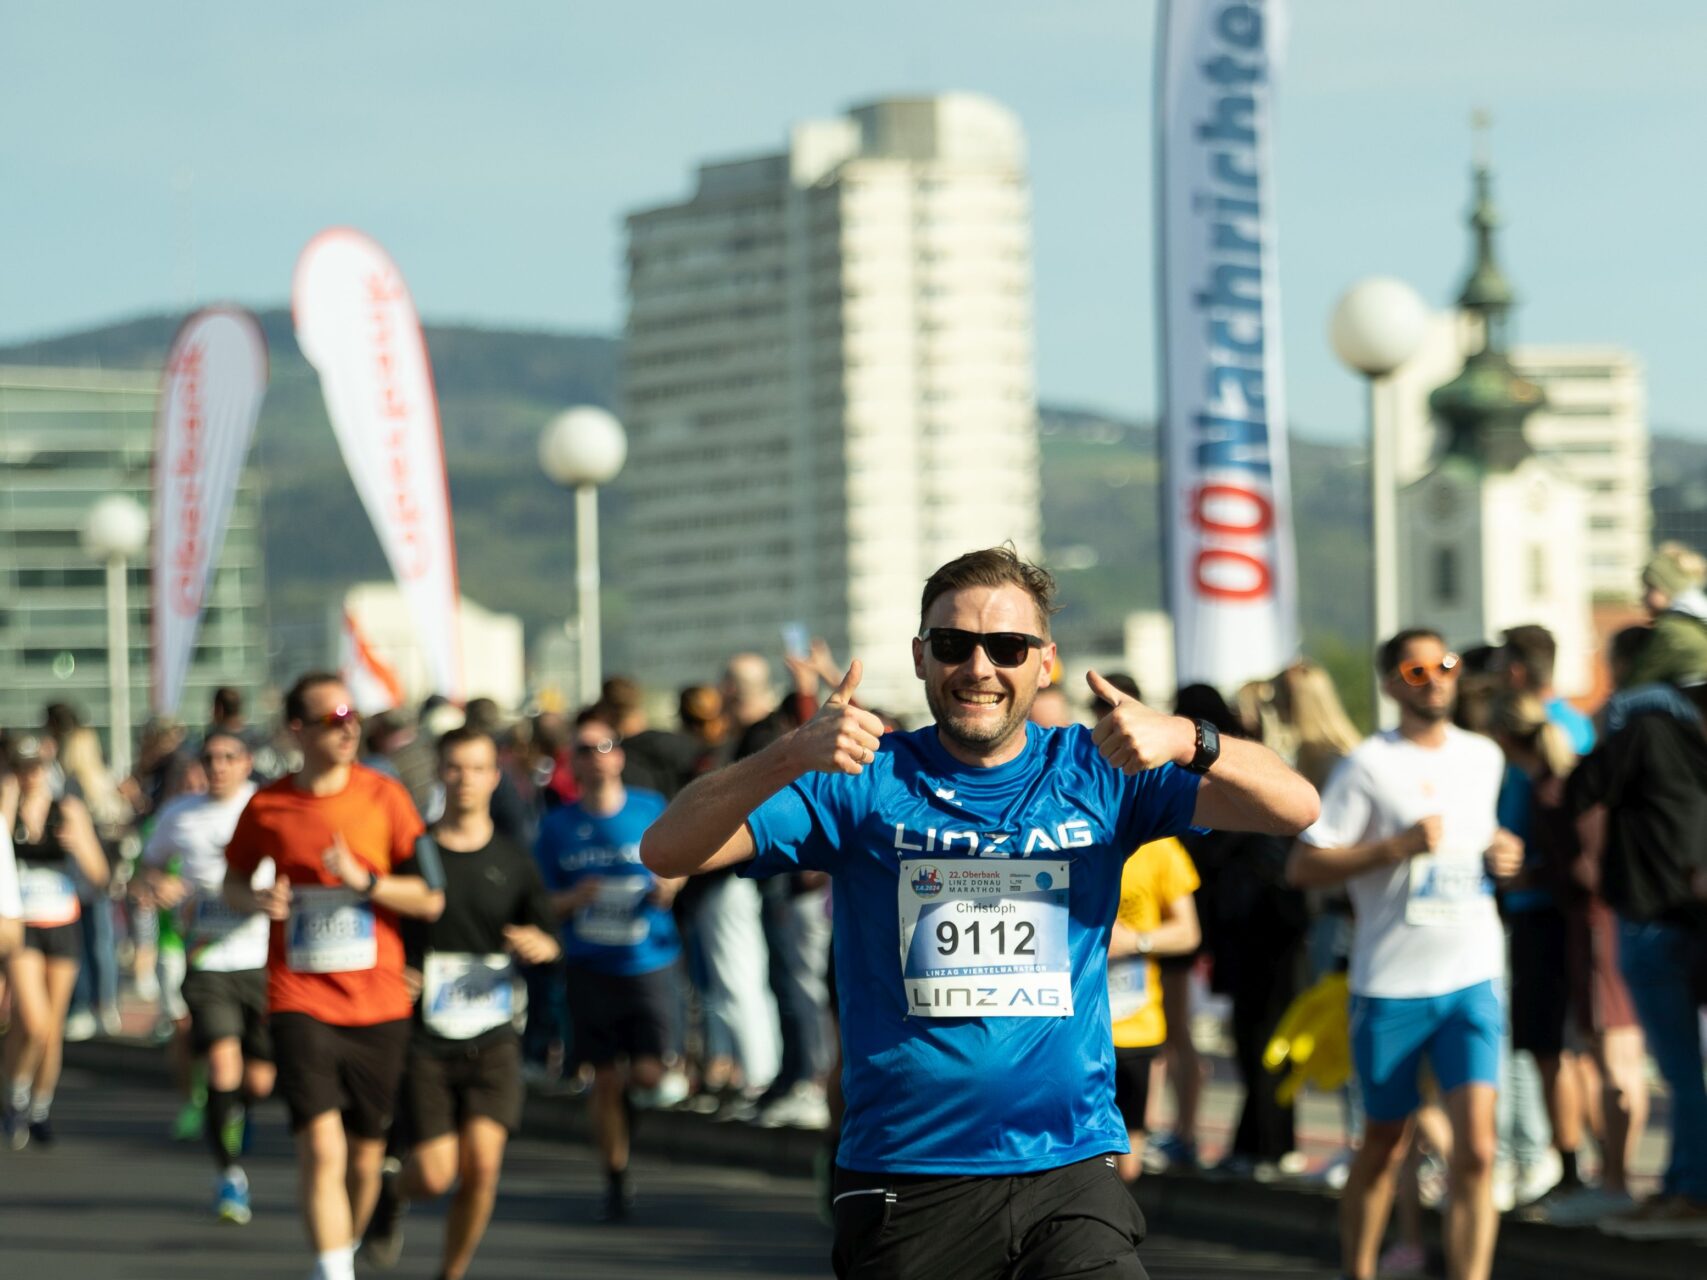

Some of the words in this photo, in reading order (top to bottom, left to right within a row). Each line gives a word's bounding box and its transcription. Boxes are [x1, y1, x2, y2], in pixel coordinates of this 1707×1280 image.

[894, 823, 1010, 858] LINZ
[1023, 820, 1093, 858] AG
[949, 871, 960, 879] 22.
[962, 870, 1000, 879] Oberbank
[956, 902, 1016, 915] Christoph
[936, 920, 1036, 956] 9112
[913, 988, 998, 1007] LINZ
[1008, 988, 1060, 1007] AG
